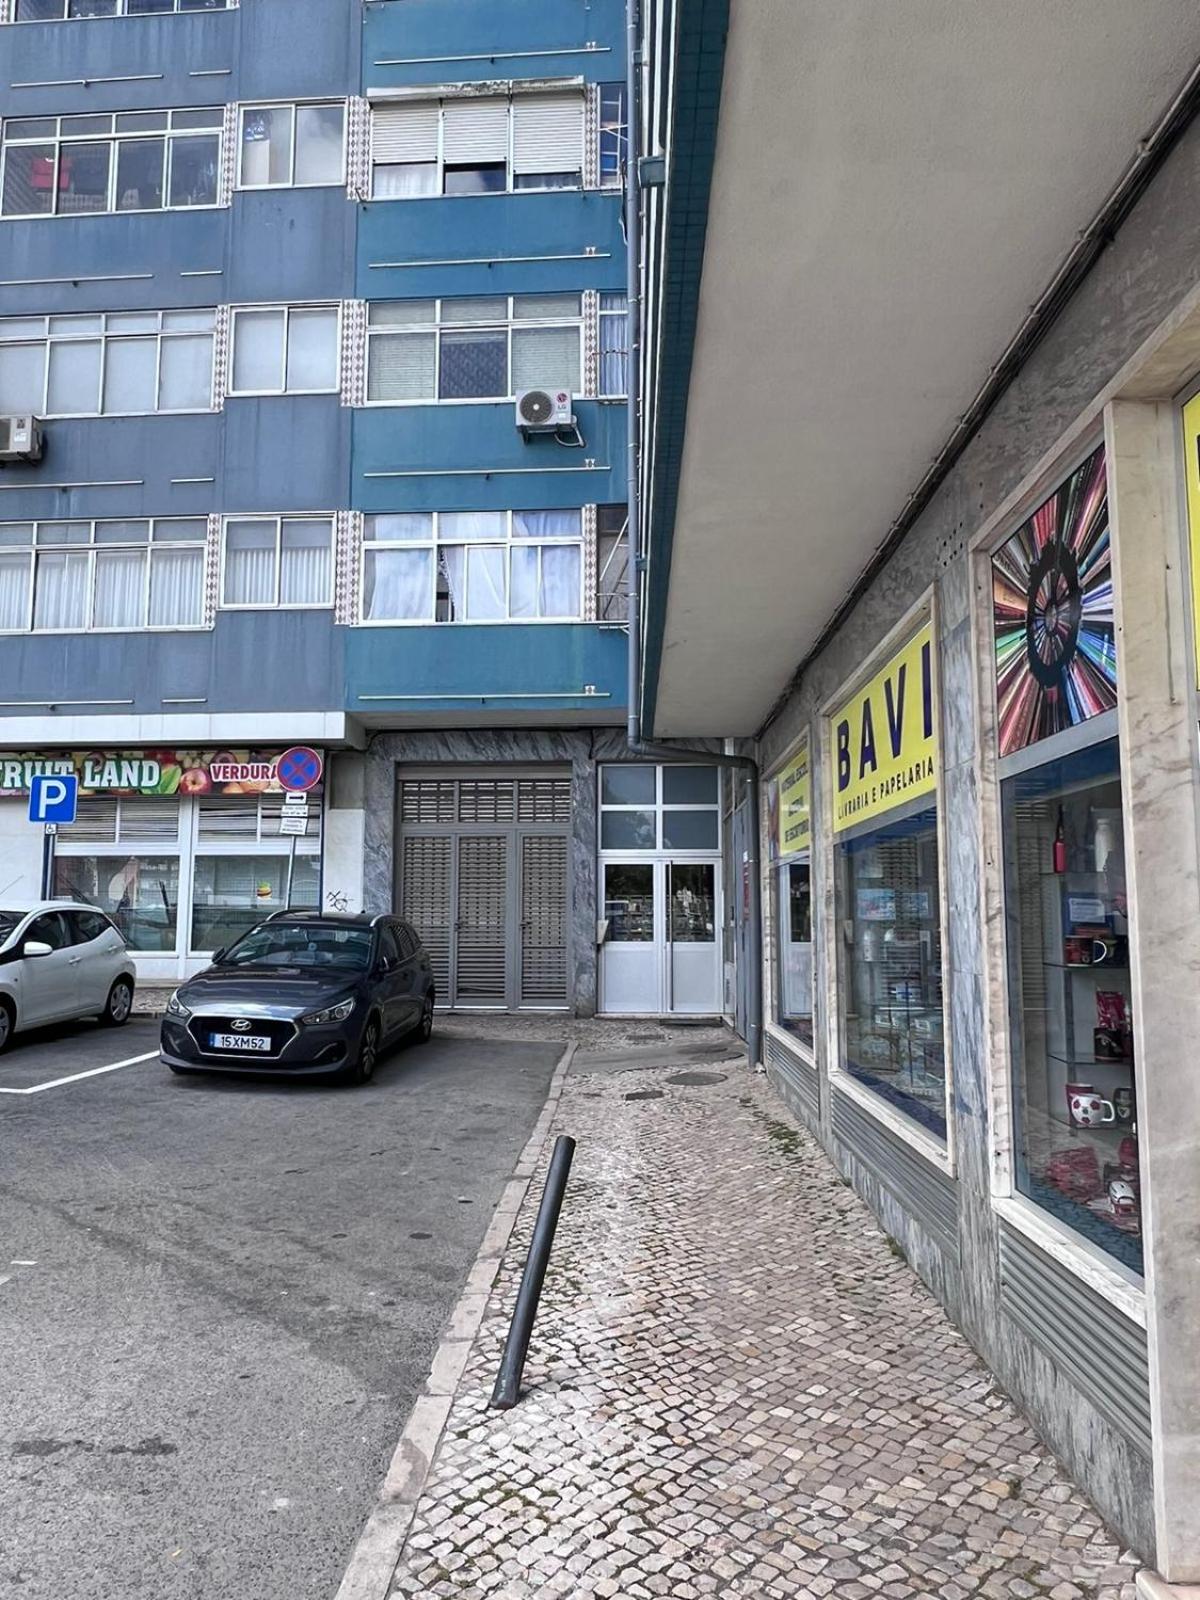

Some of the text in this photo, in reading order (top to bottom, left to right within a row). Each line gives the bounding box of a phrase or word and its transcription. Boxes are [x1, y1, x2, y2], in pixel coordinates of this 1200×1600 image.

[837, 640, 932, 792] BAVI
[84, 760, 160, 788] LAND
[838, 792, 868, 820] LIVRARIA
[872, 787, 876, 803] E
[880, 756, 934, 798] PAPELARIA
[38, 780, 67, 818] P
[221, 1036, 265, 1049] 15XM52
